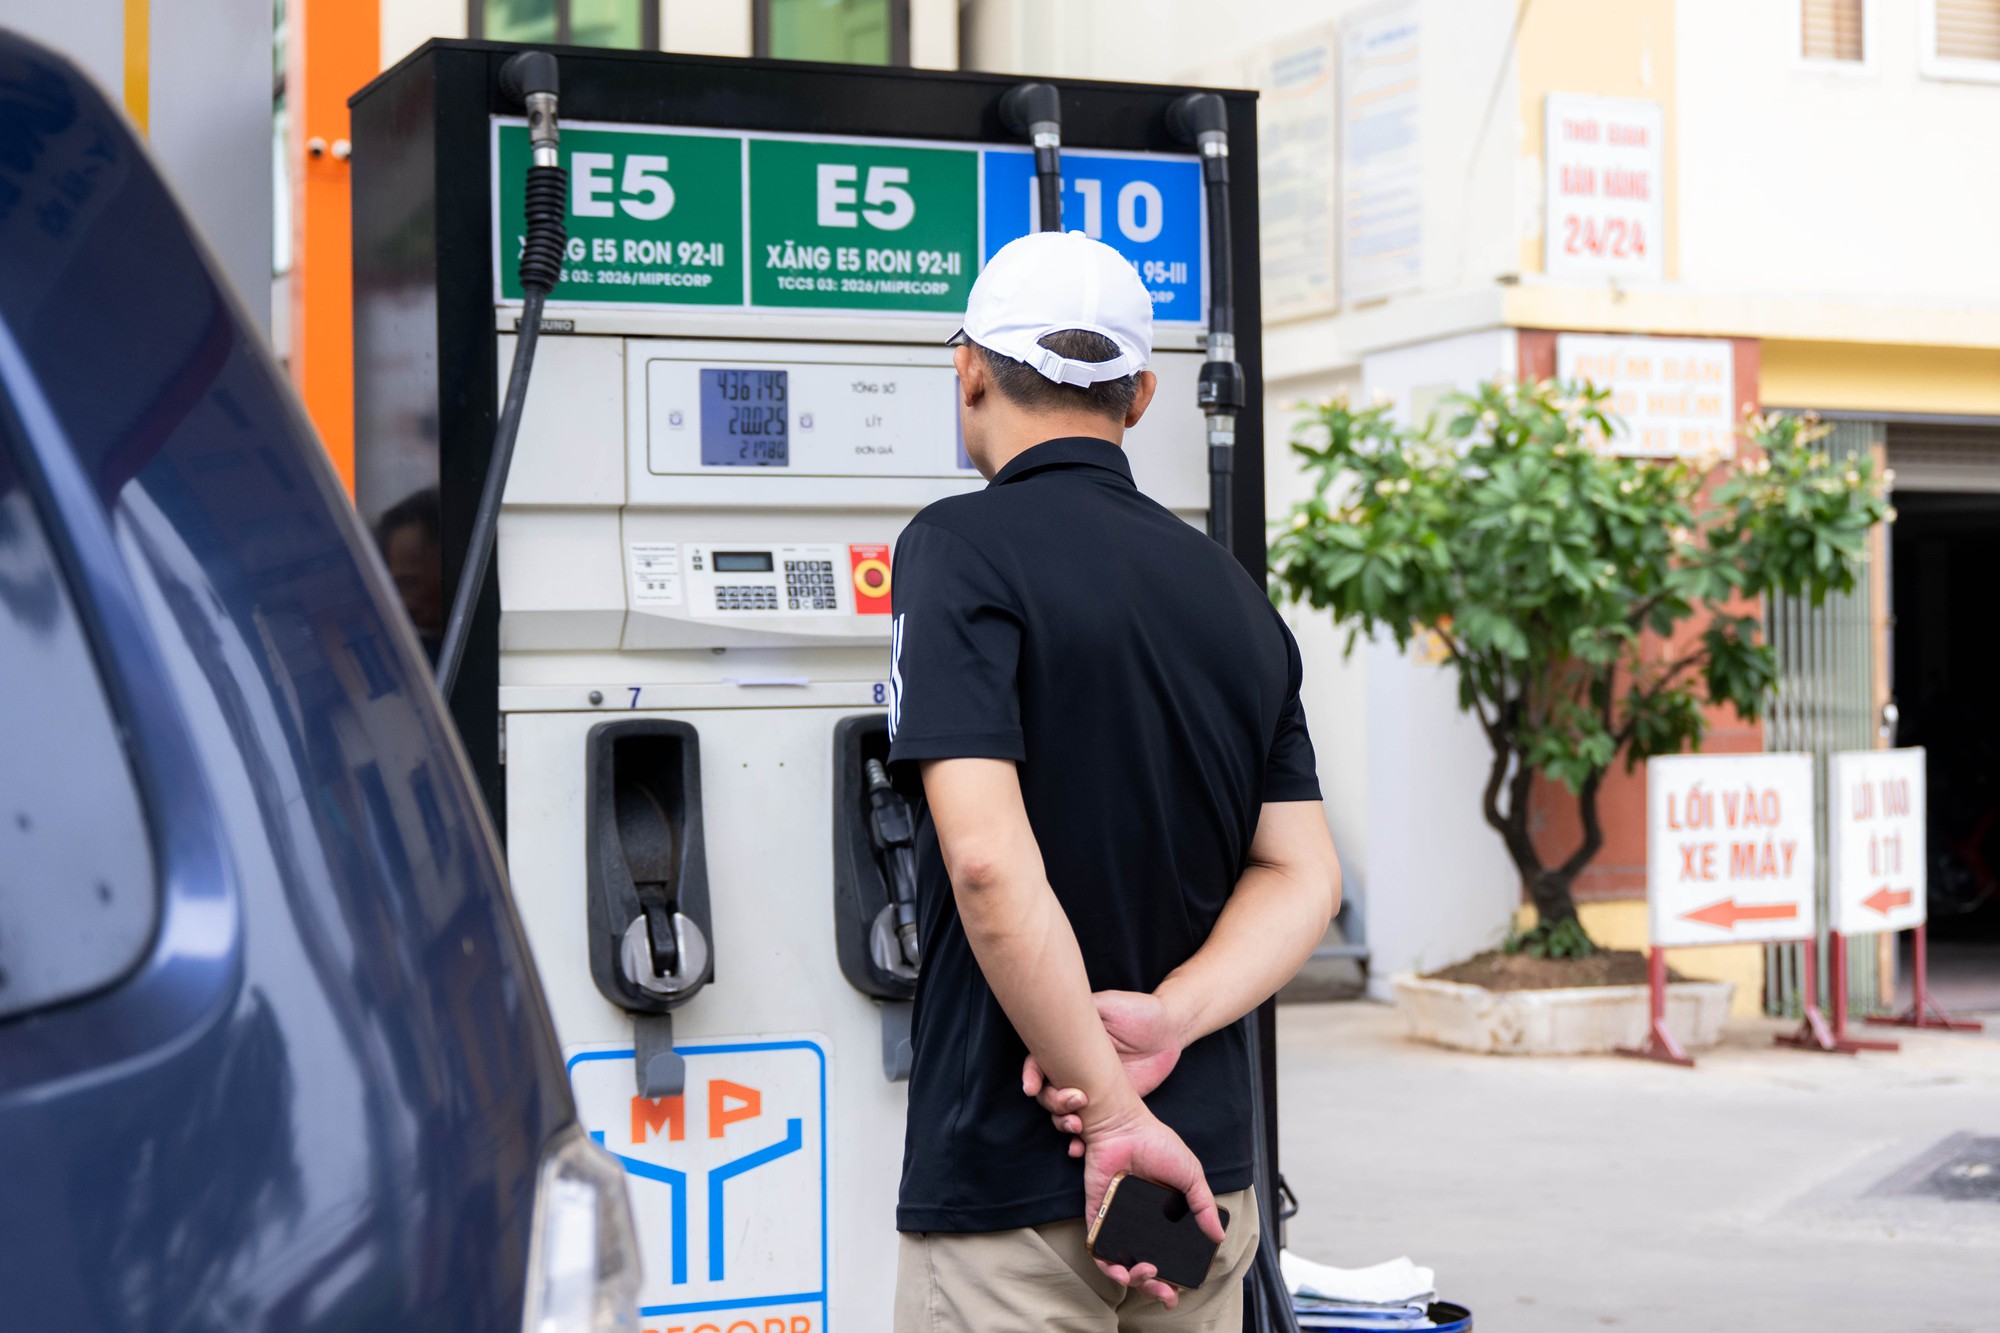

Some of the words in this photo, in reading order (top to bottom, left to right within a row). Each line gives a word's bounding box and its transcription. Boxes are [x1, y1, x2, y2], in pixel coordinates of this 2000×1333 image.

[571, 152, 675, 221] E5
[817, 163, 916, 231] E5
[592, 238, 618, 262] E5
[623, 239, 672, 265] RON
[677, 242, 724, 267] 92-II
[1564, 213, 1647, 258] 24/24
[766, 240, 831, 271] XĂNG
[837, 247, 861, 272] E5
[866, 248, 912, 274] RON
[917, 251, 961, 275] 92-II
[778, 276, 814, 291] TCCS
[627, 687, 642, 709] 7
[872, 683, 885, 704] 8
[1680, 842, 1717, 881] XE
[1730, 836, 1797, 878] MÁY
